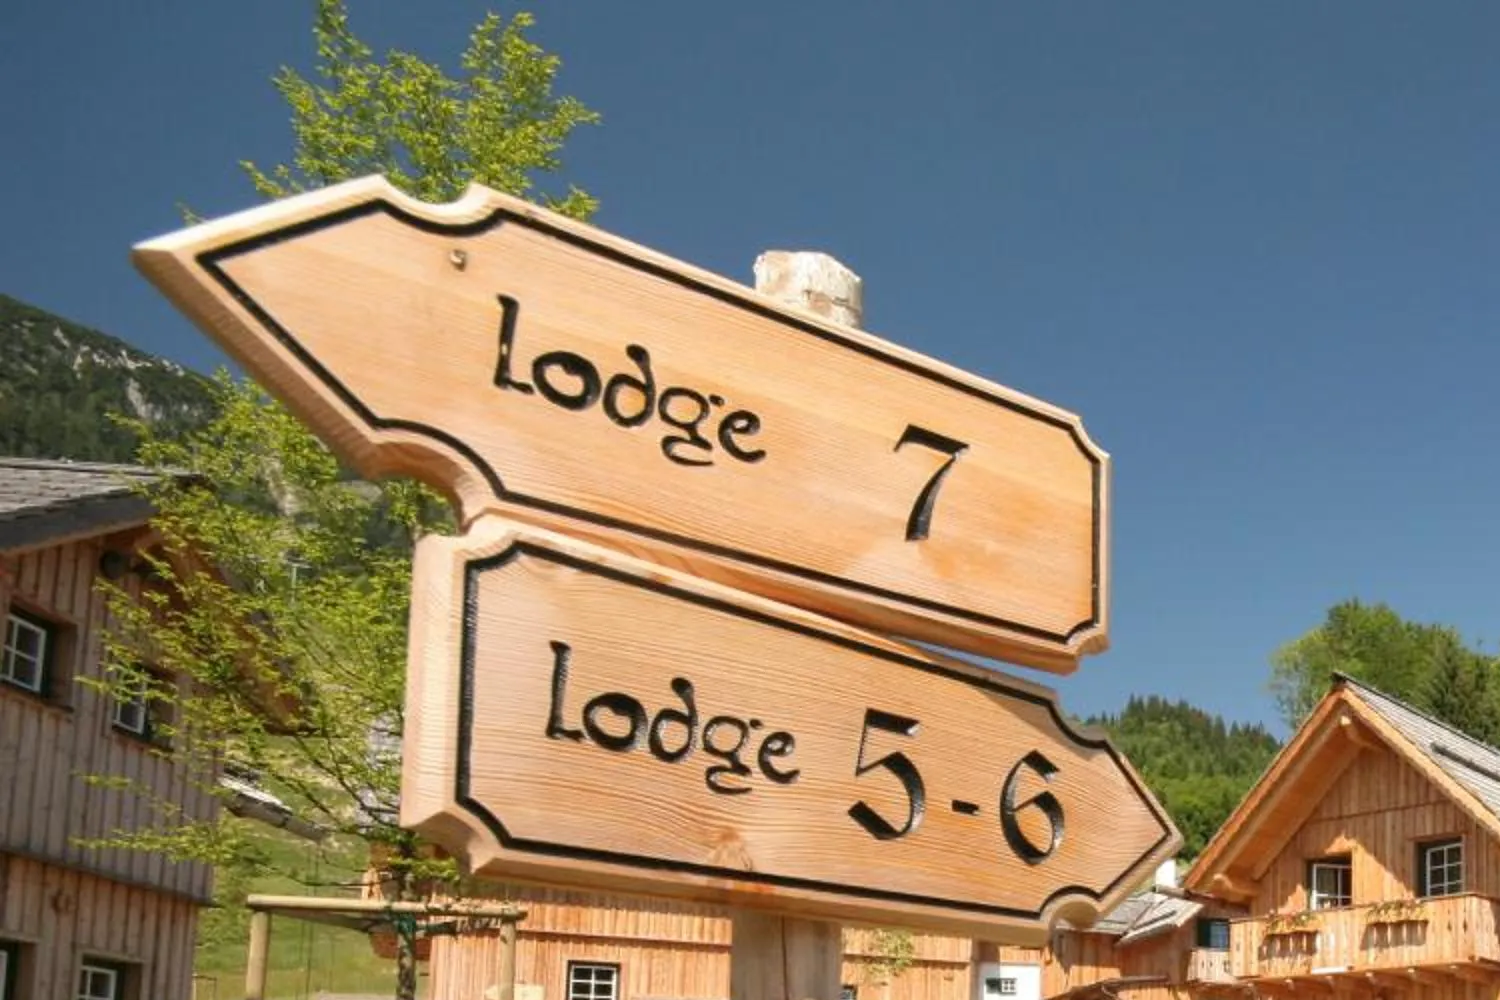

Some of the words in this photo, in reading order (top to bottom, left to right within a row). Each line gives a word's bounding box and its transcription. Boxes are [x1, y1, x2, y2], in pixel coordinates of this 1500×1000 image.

[493, 294, 766, 466] Lodge
[893, 424, 970, 541] 7
[544, 640, 800, 796] Lodge
[847, 707, 1066, 868] 5-6
